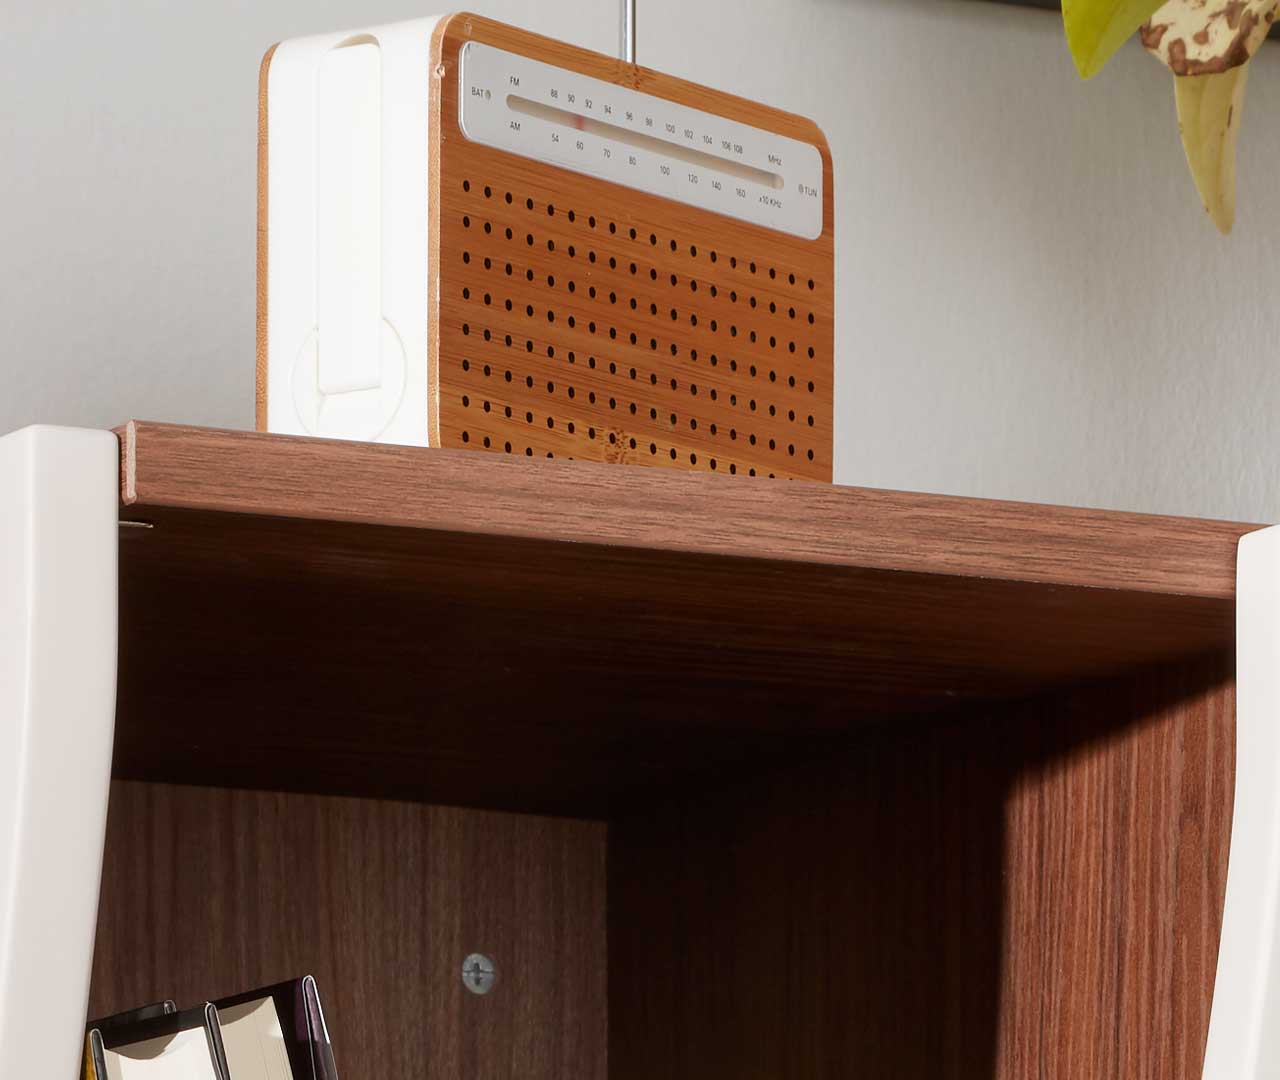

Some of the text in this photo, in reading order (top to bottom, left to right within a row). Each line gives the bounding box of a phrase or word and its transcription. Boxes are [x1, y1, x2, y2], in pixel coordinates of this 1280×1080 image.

[472, 87, 484, 98] BAT
[510, 76, 520, 86] FM
[568, 94, 575, 103] 90
[585, 99, 592, 109] 92
[604, 105, 611, 114] 94
[626, 112, 633, 120] 96
[666, 123, 675, 134] 100
[684, 129, 693, 139] 102
[703, 136, 712, 144] 104
[722, 140, 731, 151] 106
[768, 154, 782, 166] MHz
[510, 121, 520, 131] AM
[552, 133, 559, 143] 54
[576, 141, 583, 151] 60
[603, 148, 610, 158] 70
[629, 156, 636, 165] 80
[660, 166, 670, 176] 100
[688, 173, 698, 184] 120
[712, 181, 721, 191] 140
[736, 188, 745, 198] 160
[805, 186, 817, 197] TUN
